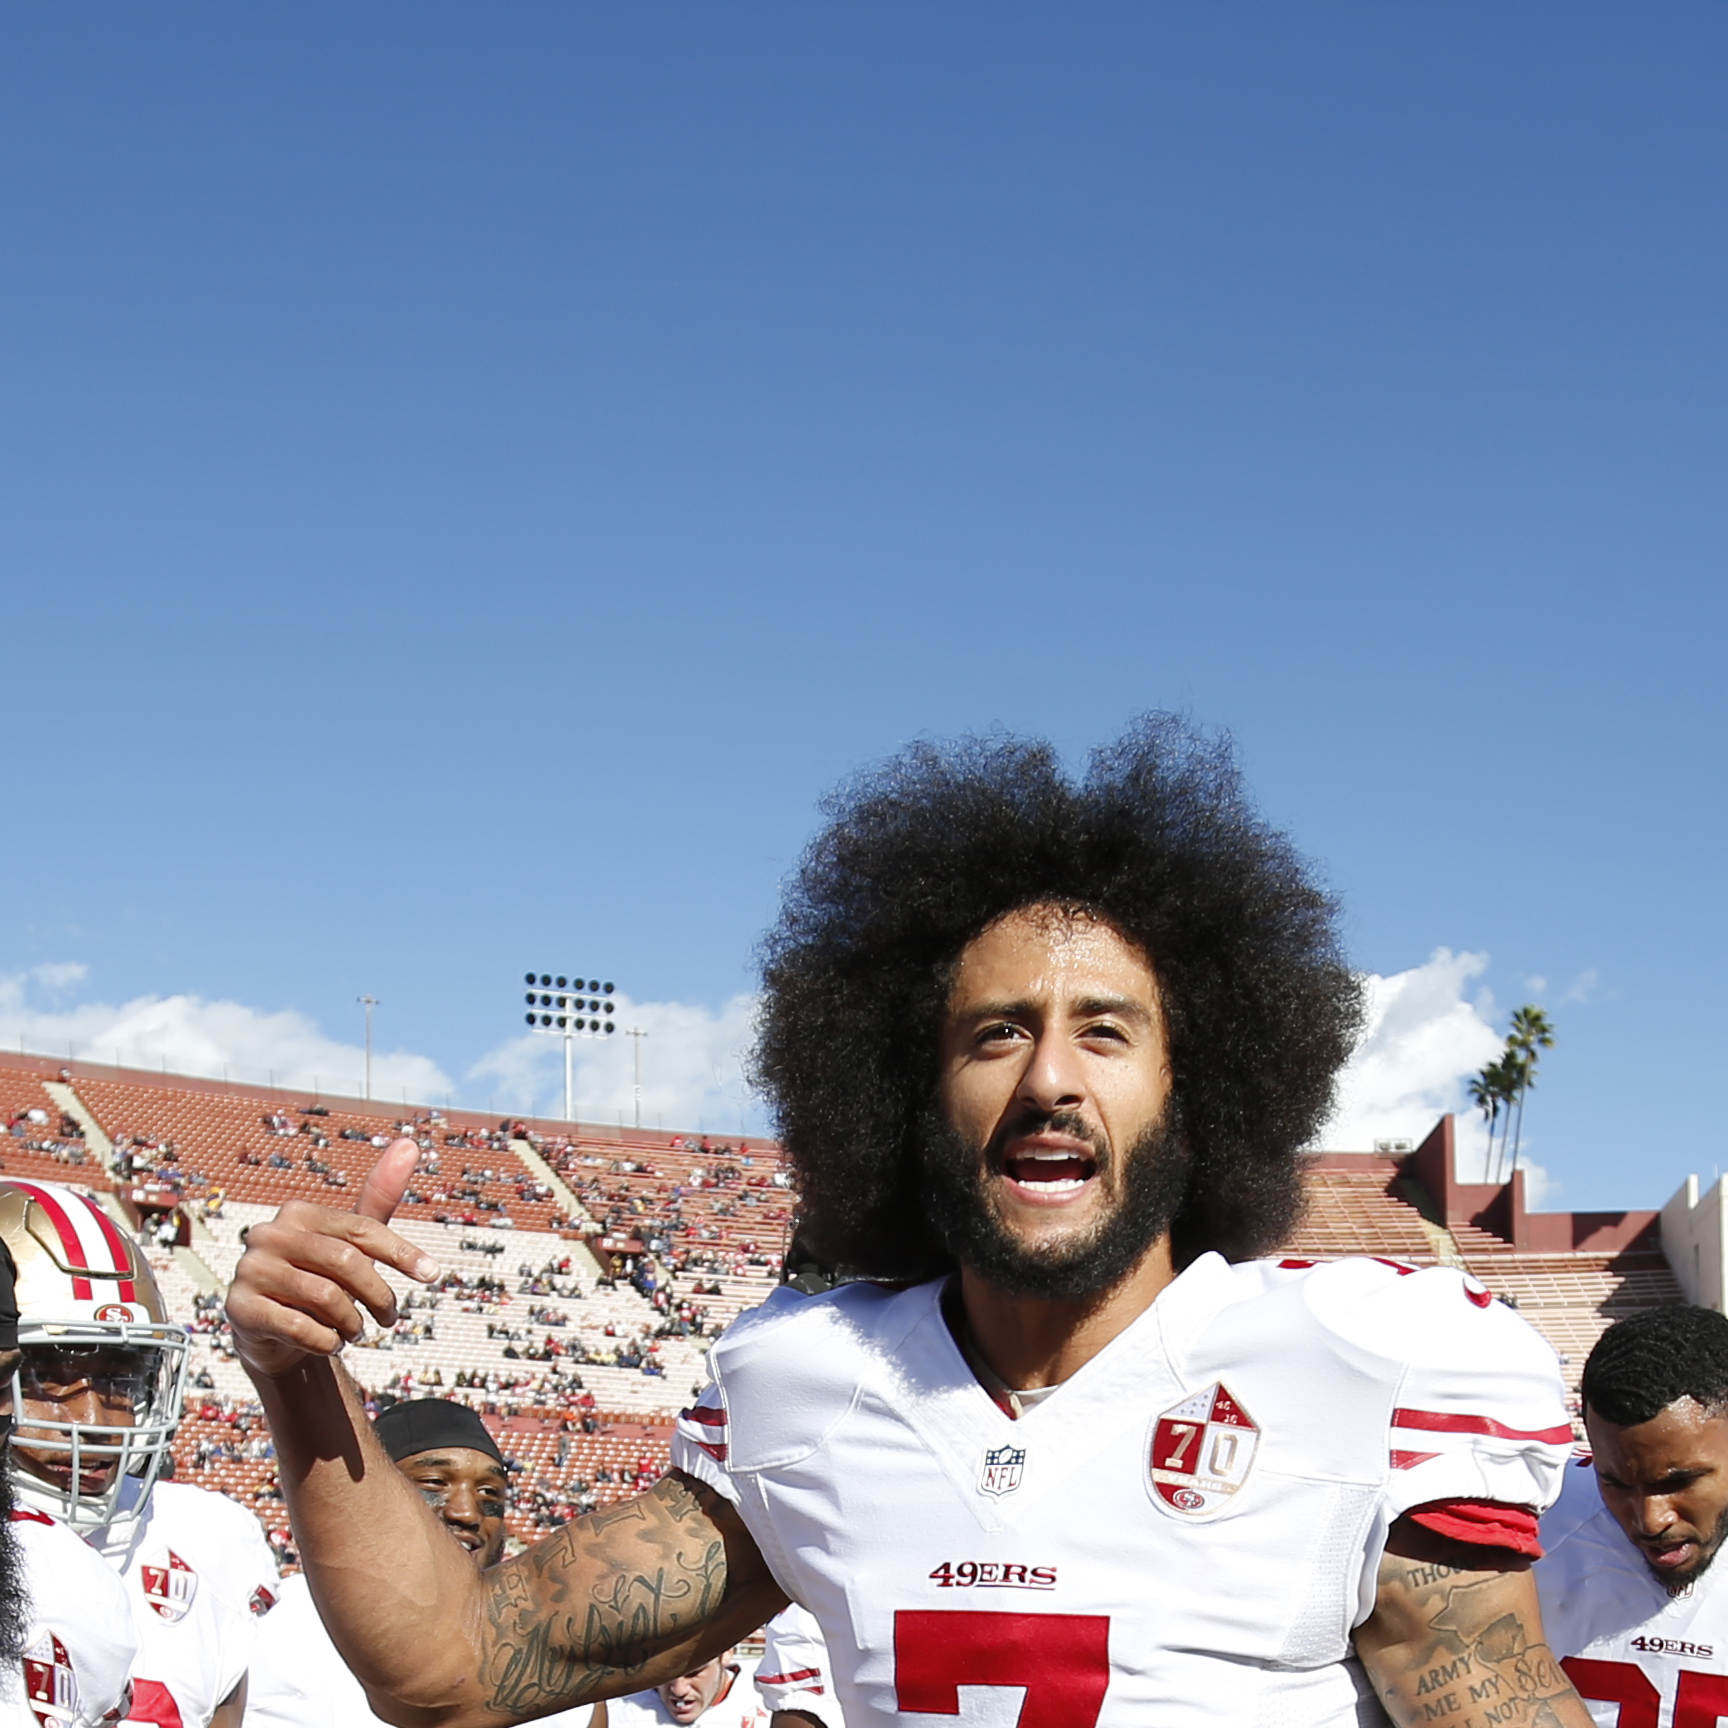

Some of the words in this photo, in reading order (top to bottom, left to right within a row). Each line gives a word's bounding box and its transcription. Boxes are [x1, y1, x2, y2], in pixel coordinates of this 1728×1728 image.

[1165, 1424, 1238, 1476] 70
[986, 1466, 1017, 1490] NFL
[928, 1561, 1057, 1590] 49ERS
[1630, 1636, 1713, 1659] 49ERS
[1416, 1652, 1472, 1696] ARMY
[1424, 1693, 1461, 1721] ME
[1469, 1674, 1500, 1703] MY
[1483, 1696, 1520, 1728] NOT
